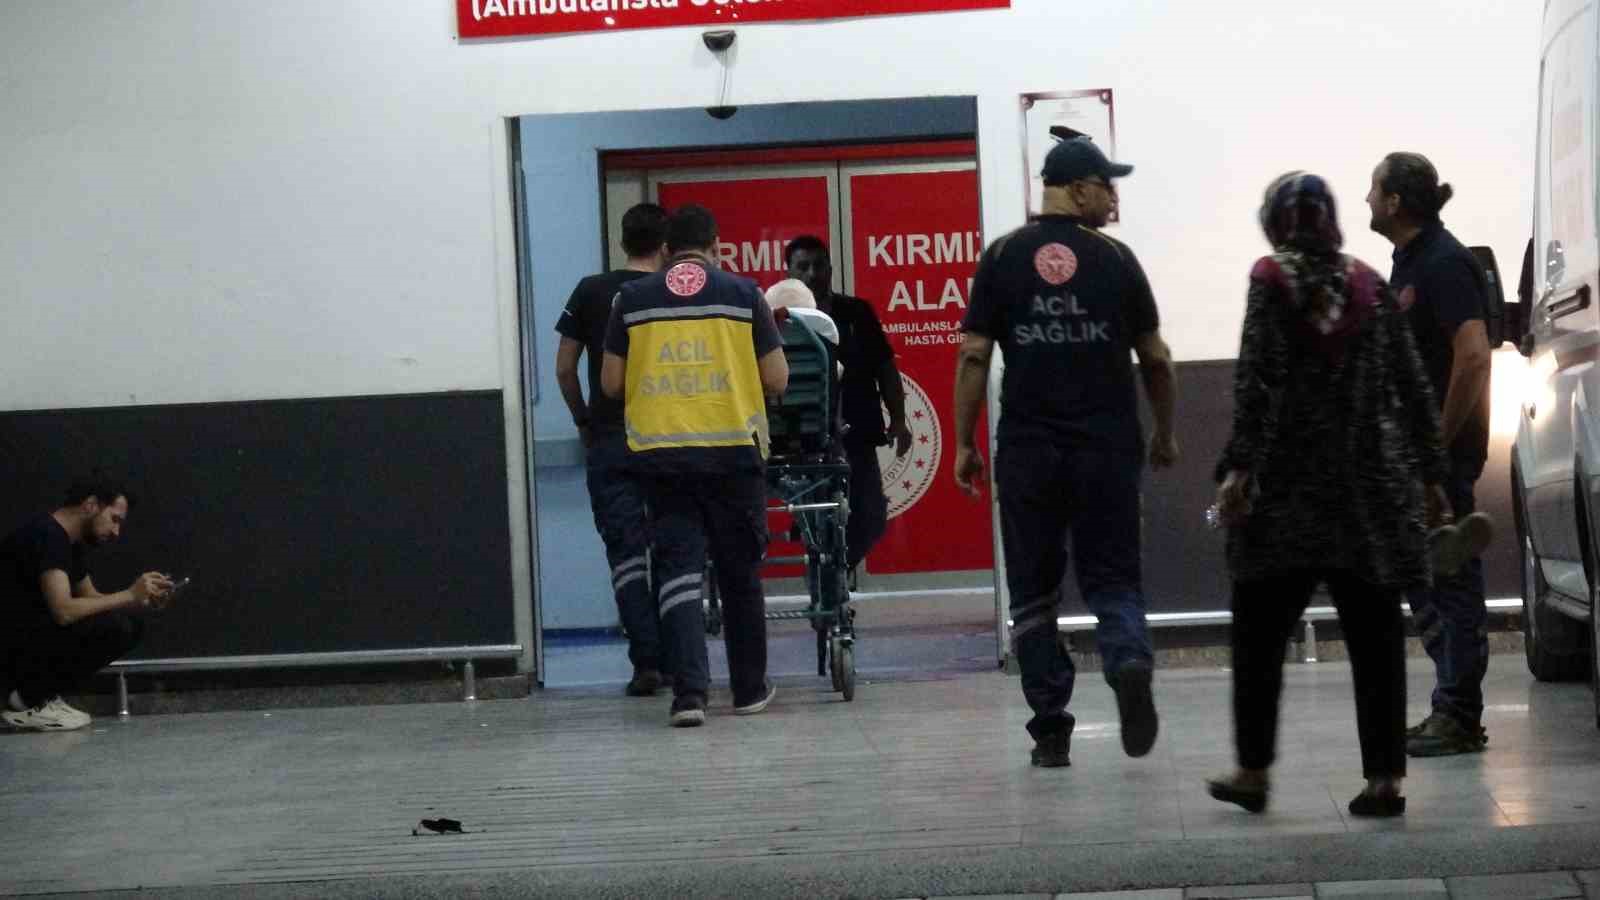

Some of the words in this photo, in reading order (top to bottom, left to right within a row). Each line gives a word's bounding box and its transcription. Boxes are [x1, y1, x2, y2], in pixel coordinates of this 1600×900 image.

[867, 231, 980, 267] KIRMI
[888, 277, 975, 312] ALA
[905, 335, 944, 346] HASTA
[1015, 319, 1111, 345] SAĞLIK
[658, 337, 714, 363] ACİL
[640, 370, 733, 397] SAĞLIK
